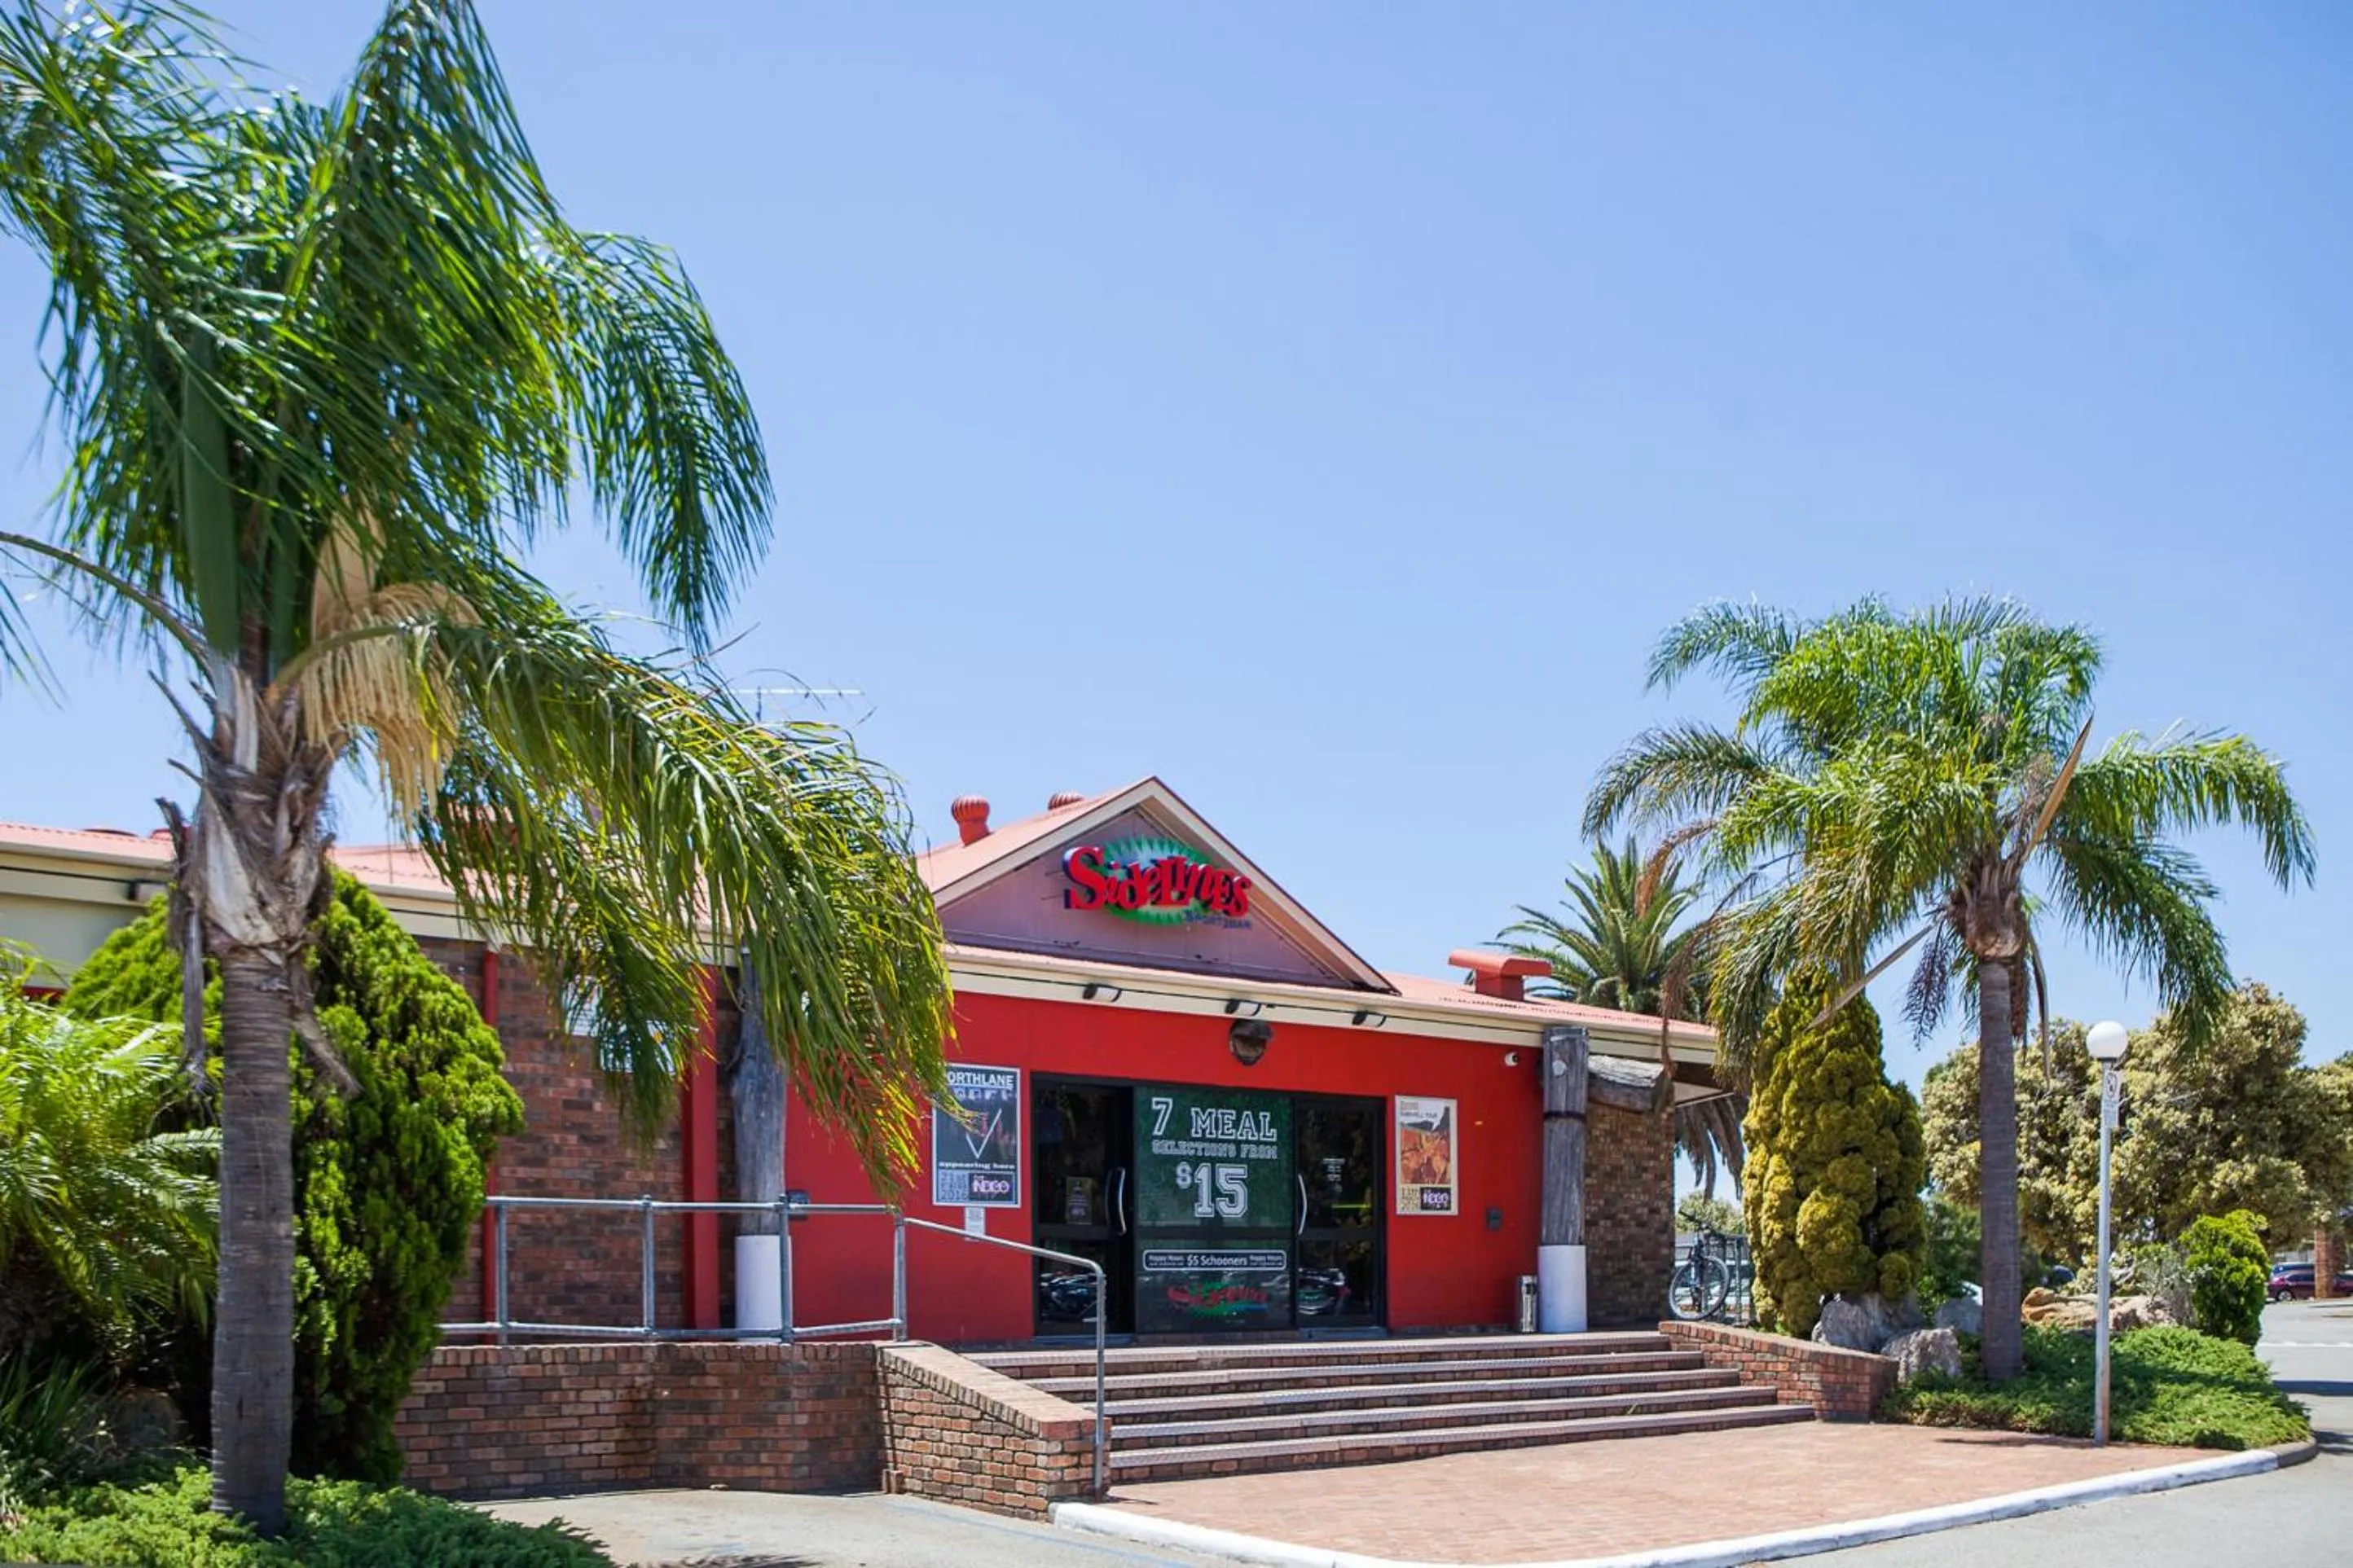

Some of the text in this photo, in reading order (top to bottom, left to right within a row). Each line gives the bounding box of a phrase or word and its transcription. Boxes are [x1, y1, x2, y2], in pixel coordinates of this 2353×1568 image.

[946, 1070, 1014, 1087] ORTHLANE
[1151, 1096, 1278, 1141] 7 MEAL
[1176, 1161, 1248, 1218] $15
[1200, 1254, 1248, 1267] Schooners
